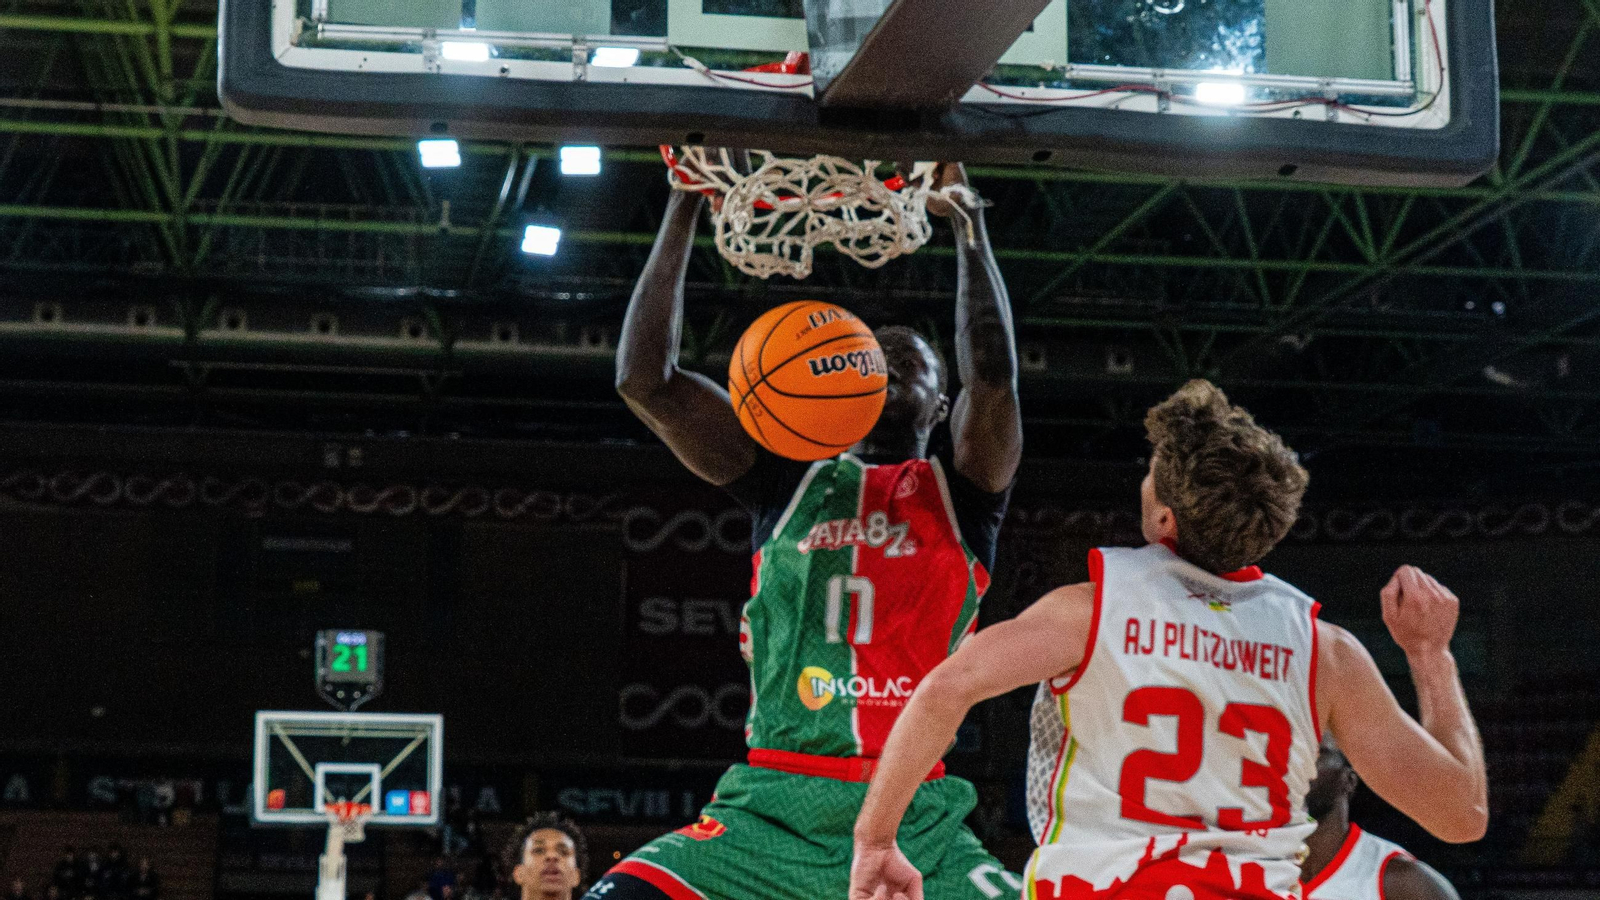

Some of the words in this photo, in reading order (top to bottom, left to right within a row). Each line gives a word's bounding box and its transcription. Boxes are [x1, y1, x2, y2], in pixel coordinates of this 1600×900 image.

[825, 575, 875, 644] 17
[332, 643, 368, 672] 21
[1124, 617, 1156, 655] AJ
[1164, 621, 1294, 682] PLITZUWEIT
[810, 676, 913, 698] INSOLAC
[1118, 686, 1292, 831] 23
